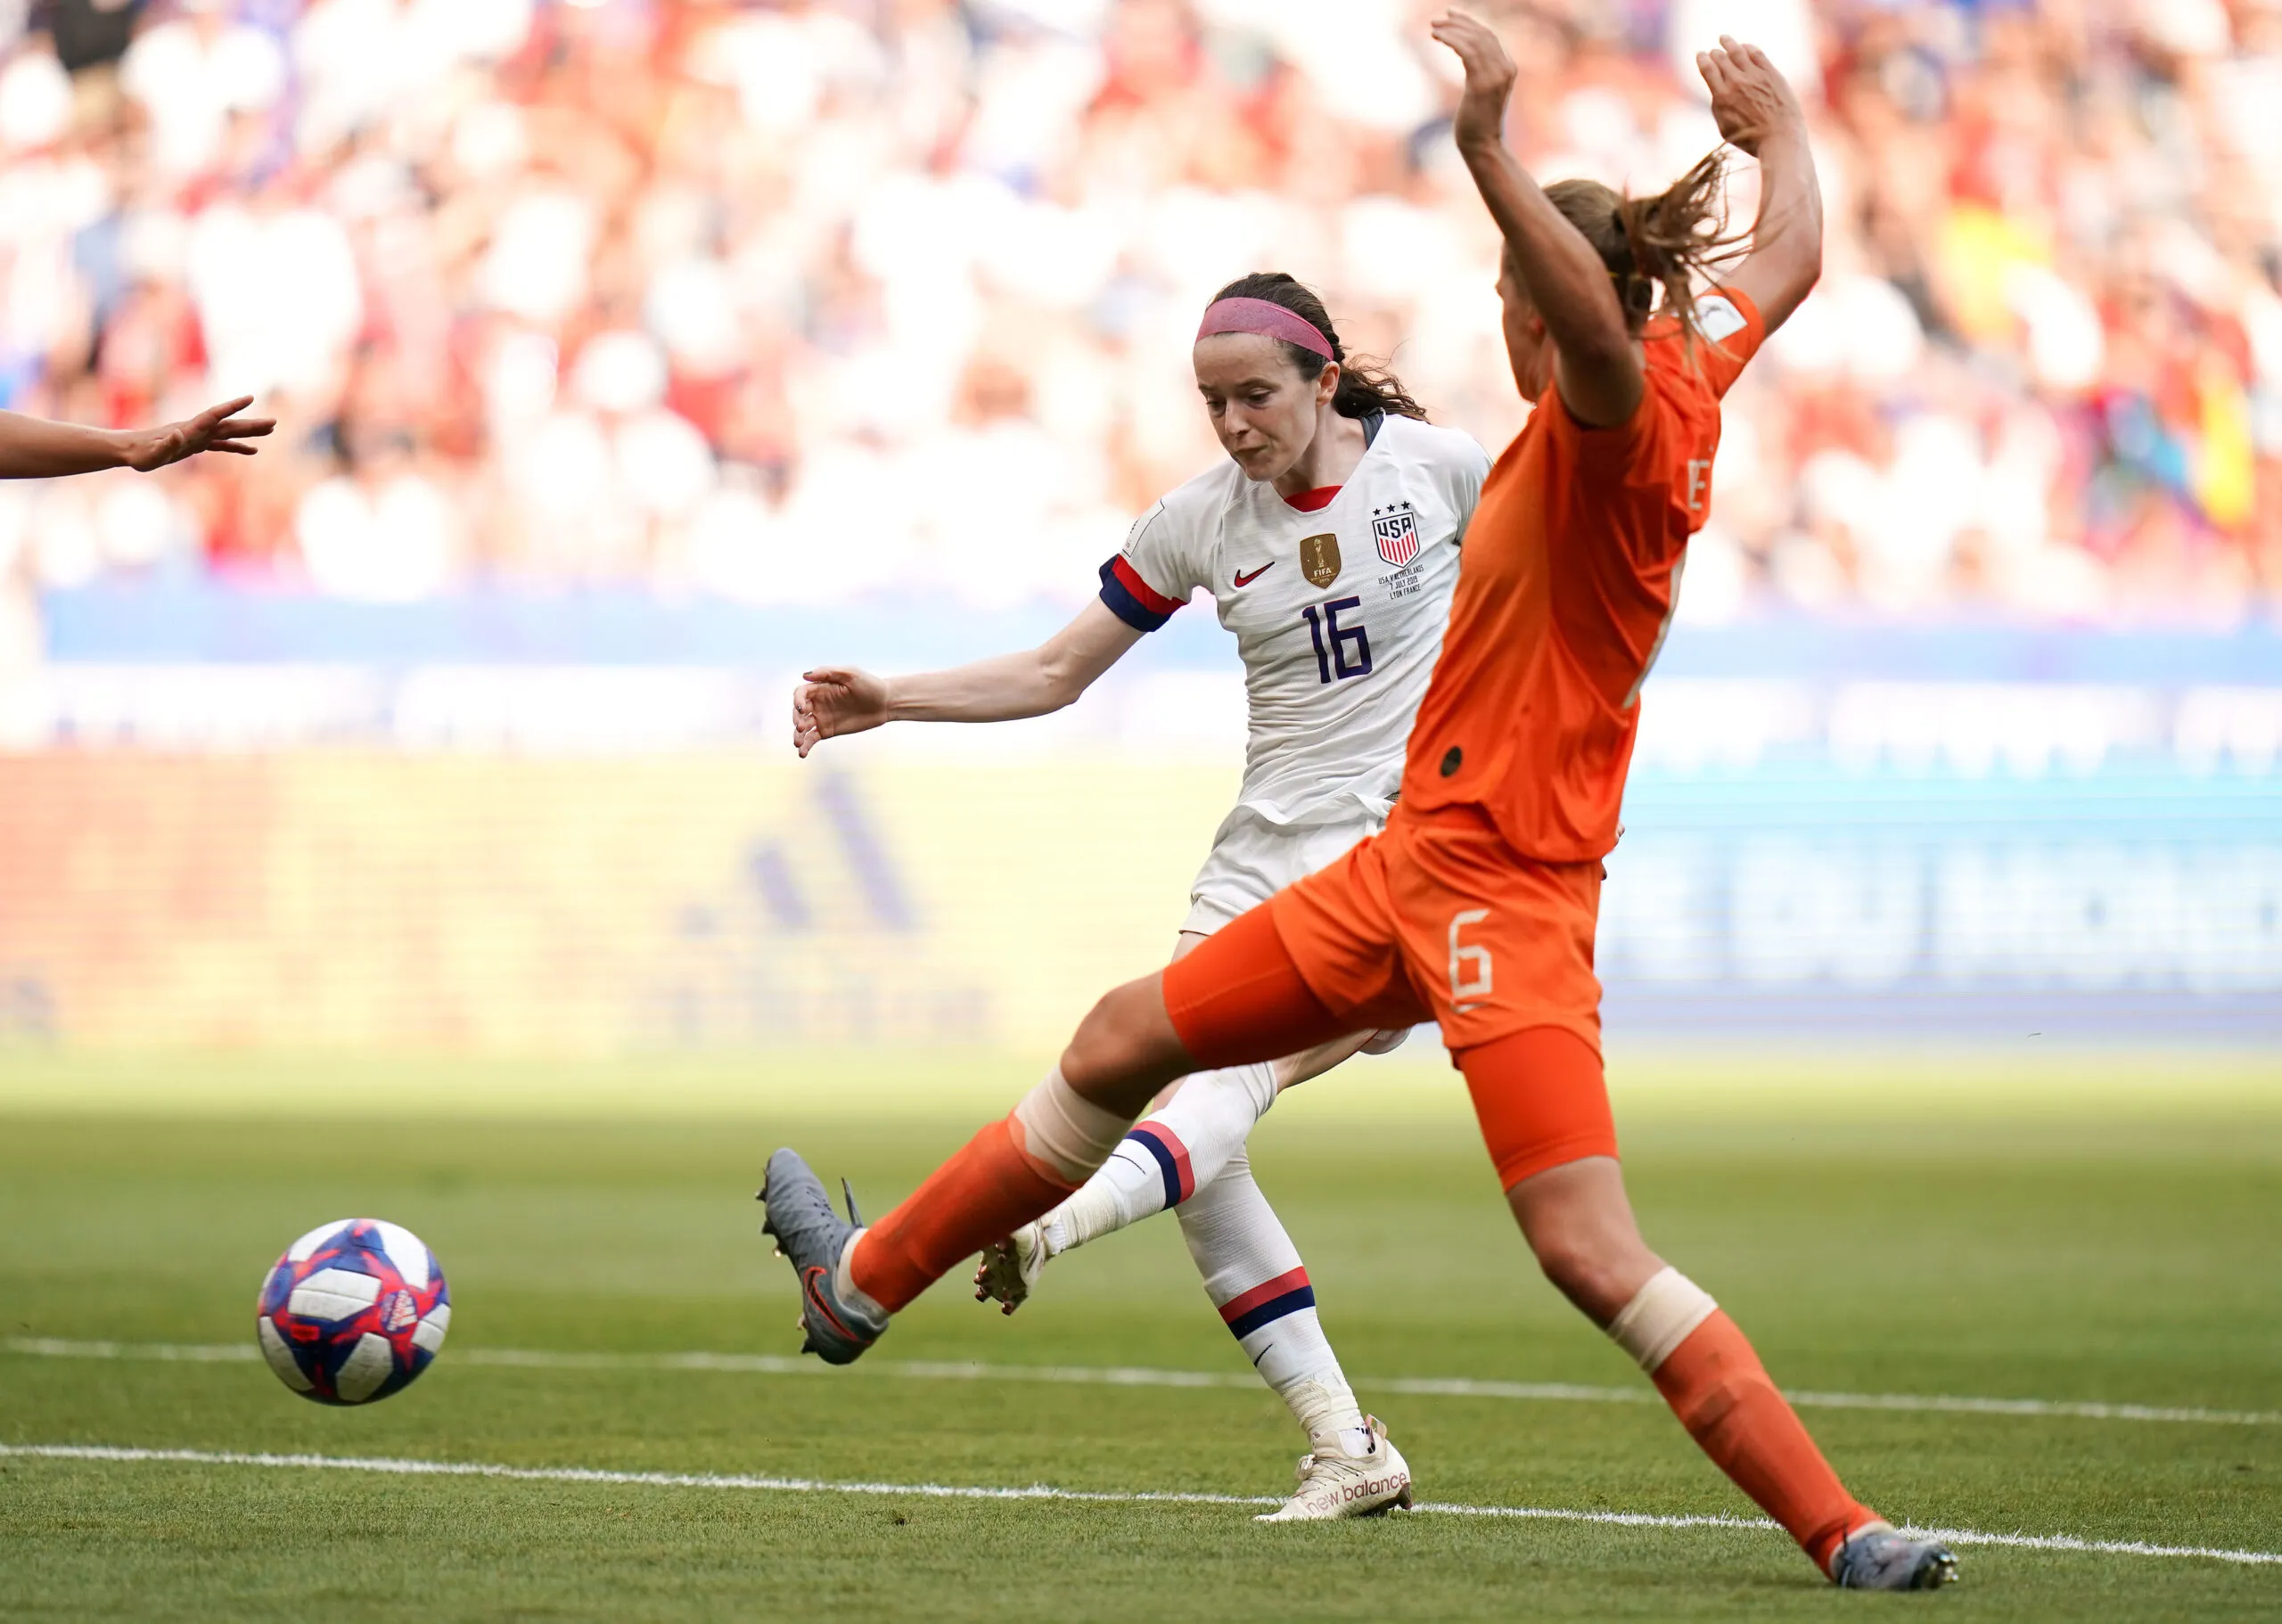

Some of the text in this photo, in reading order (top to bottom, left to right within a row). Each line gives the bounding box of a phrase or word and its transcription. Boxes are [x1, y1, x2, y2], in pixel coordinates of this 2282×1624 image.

[1377, 517, 1412, 538] USA
[1314, 567, 1332, 577] FIFA
[1378, 576, 1390, 585] USA
[1393, 564, 1424, 579] NETHERLANDS
[1390, 584, 1421, 600] LYON FRANCE
[1395, 579, 1406, 589] JULY
[1302, 595, 1373, 684] 16
[1449, 908, 1492, 999] 6
[1307, 1472, 1408, 1514] new balance
